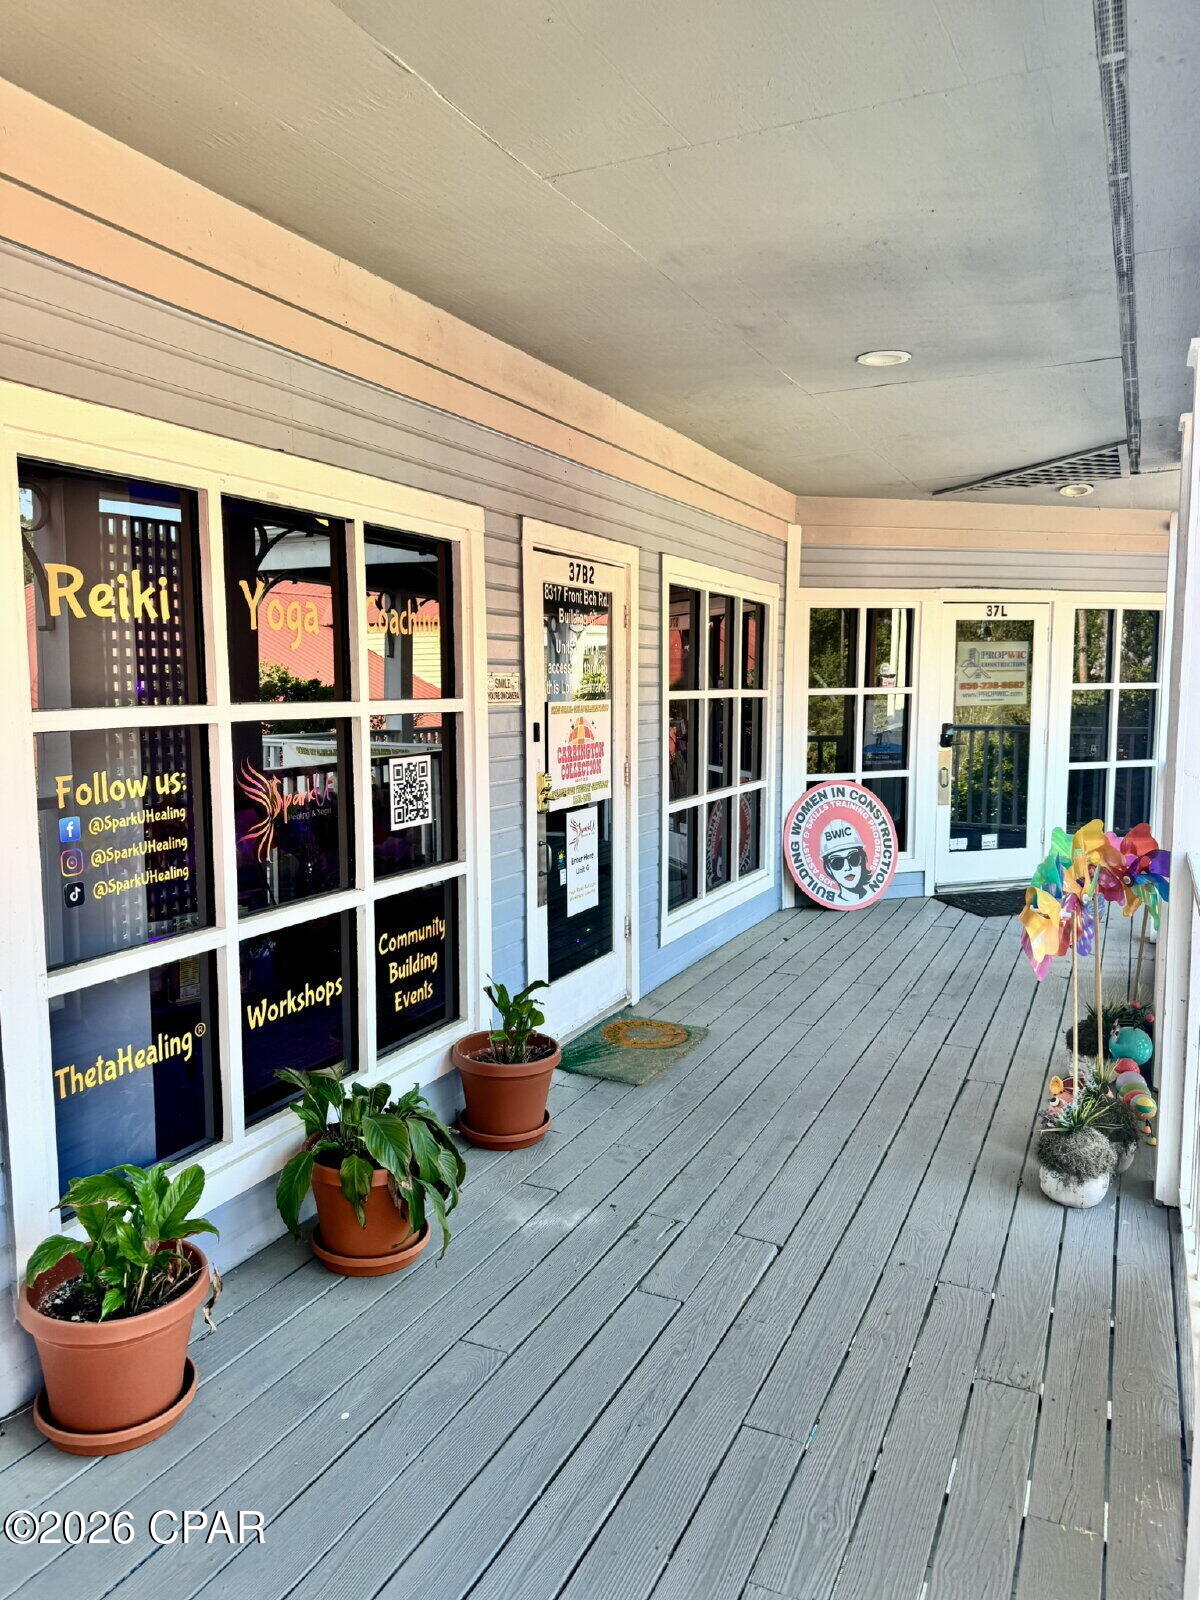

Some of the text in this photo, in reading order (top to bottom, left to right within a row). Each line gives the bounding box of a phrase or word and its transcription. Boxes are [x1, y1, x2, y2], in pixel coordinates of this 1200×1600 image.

[568, 562, 595, 584] 37B2
[44, 563, 171, 624] Reiki
[543, 583, 562, 601] 8317
[563, 588, 583, 605] Front
[583, 591, 597, 606] Bch
[239, 578, 320, 649] Yoga
[366, 594, 441, 645] Coaching
[986, 605, 1008, 617] 37L
[980, 650, 1027, 660] PROPWIC
[495, 678, 511, 689] SMILE
[561, 758, 602, 780] COLLECTION
[55, 770, 187, 809] Follow us:
[830, 787, 846, 798] IN
[88, 806, 186, 835] @SparkUHealing
[791, 789, 829, 836] WOMEN
[807, 801, 830, 830] SKILLS
[830, 800, 869, 819] TRAINING
[824, 827, 852, 841] BWIC
[849, 789, 893, 893] CONSTRUCTION
[869, 819, 881, 872] PROGRAMS
[91, 836, 188, 867] @SparkUHealing
[571, 852, 594, 866] Enter Here
[802, 841, 820, 875] ASSIST
[93, 866, 189, 899] @SparkUHealing
[791, 841, 836, 902] BUILDING
[378, 917, 446, 955] Community
[388, 951, 438, 984] Building
[246, 976, 343, 1031] Workshops
[394, 980, 434, 1012] Events
